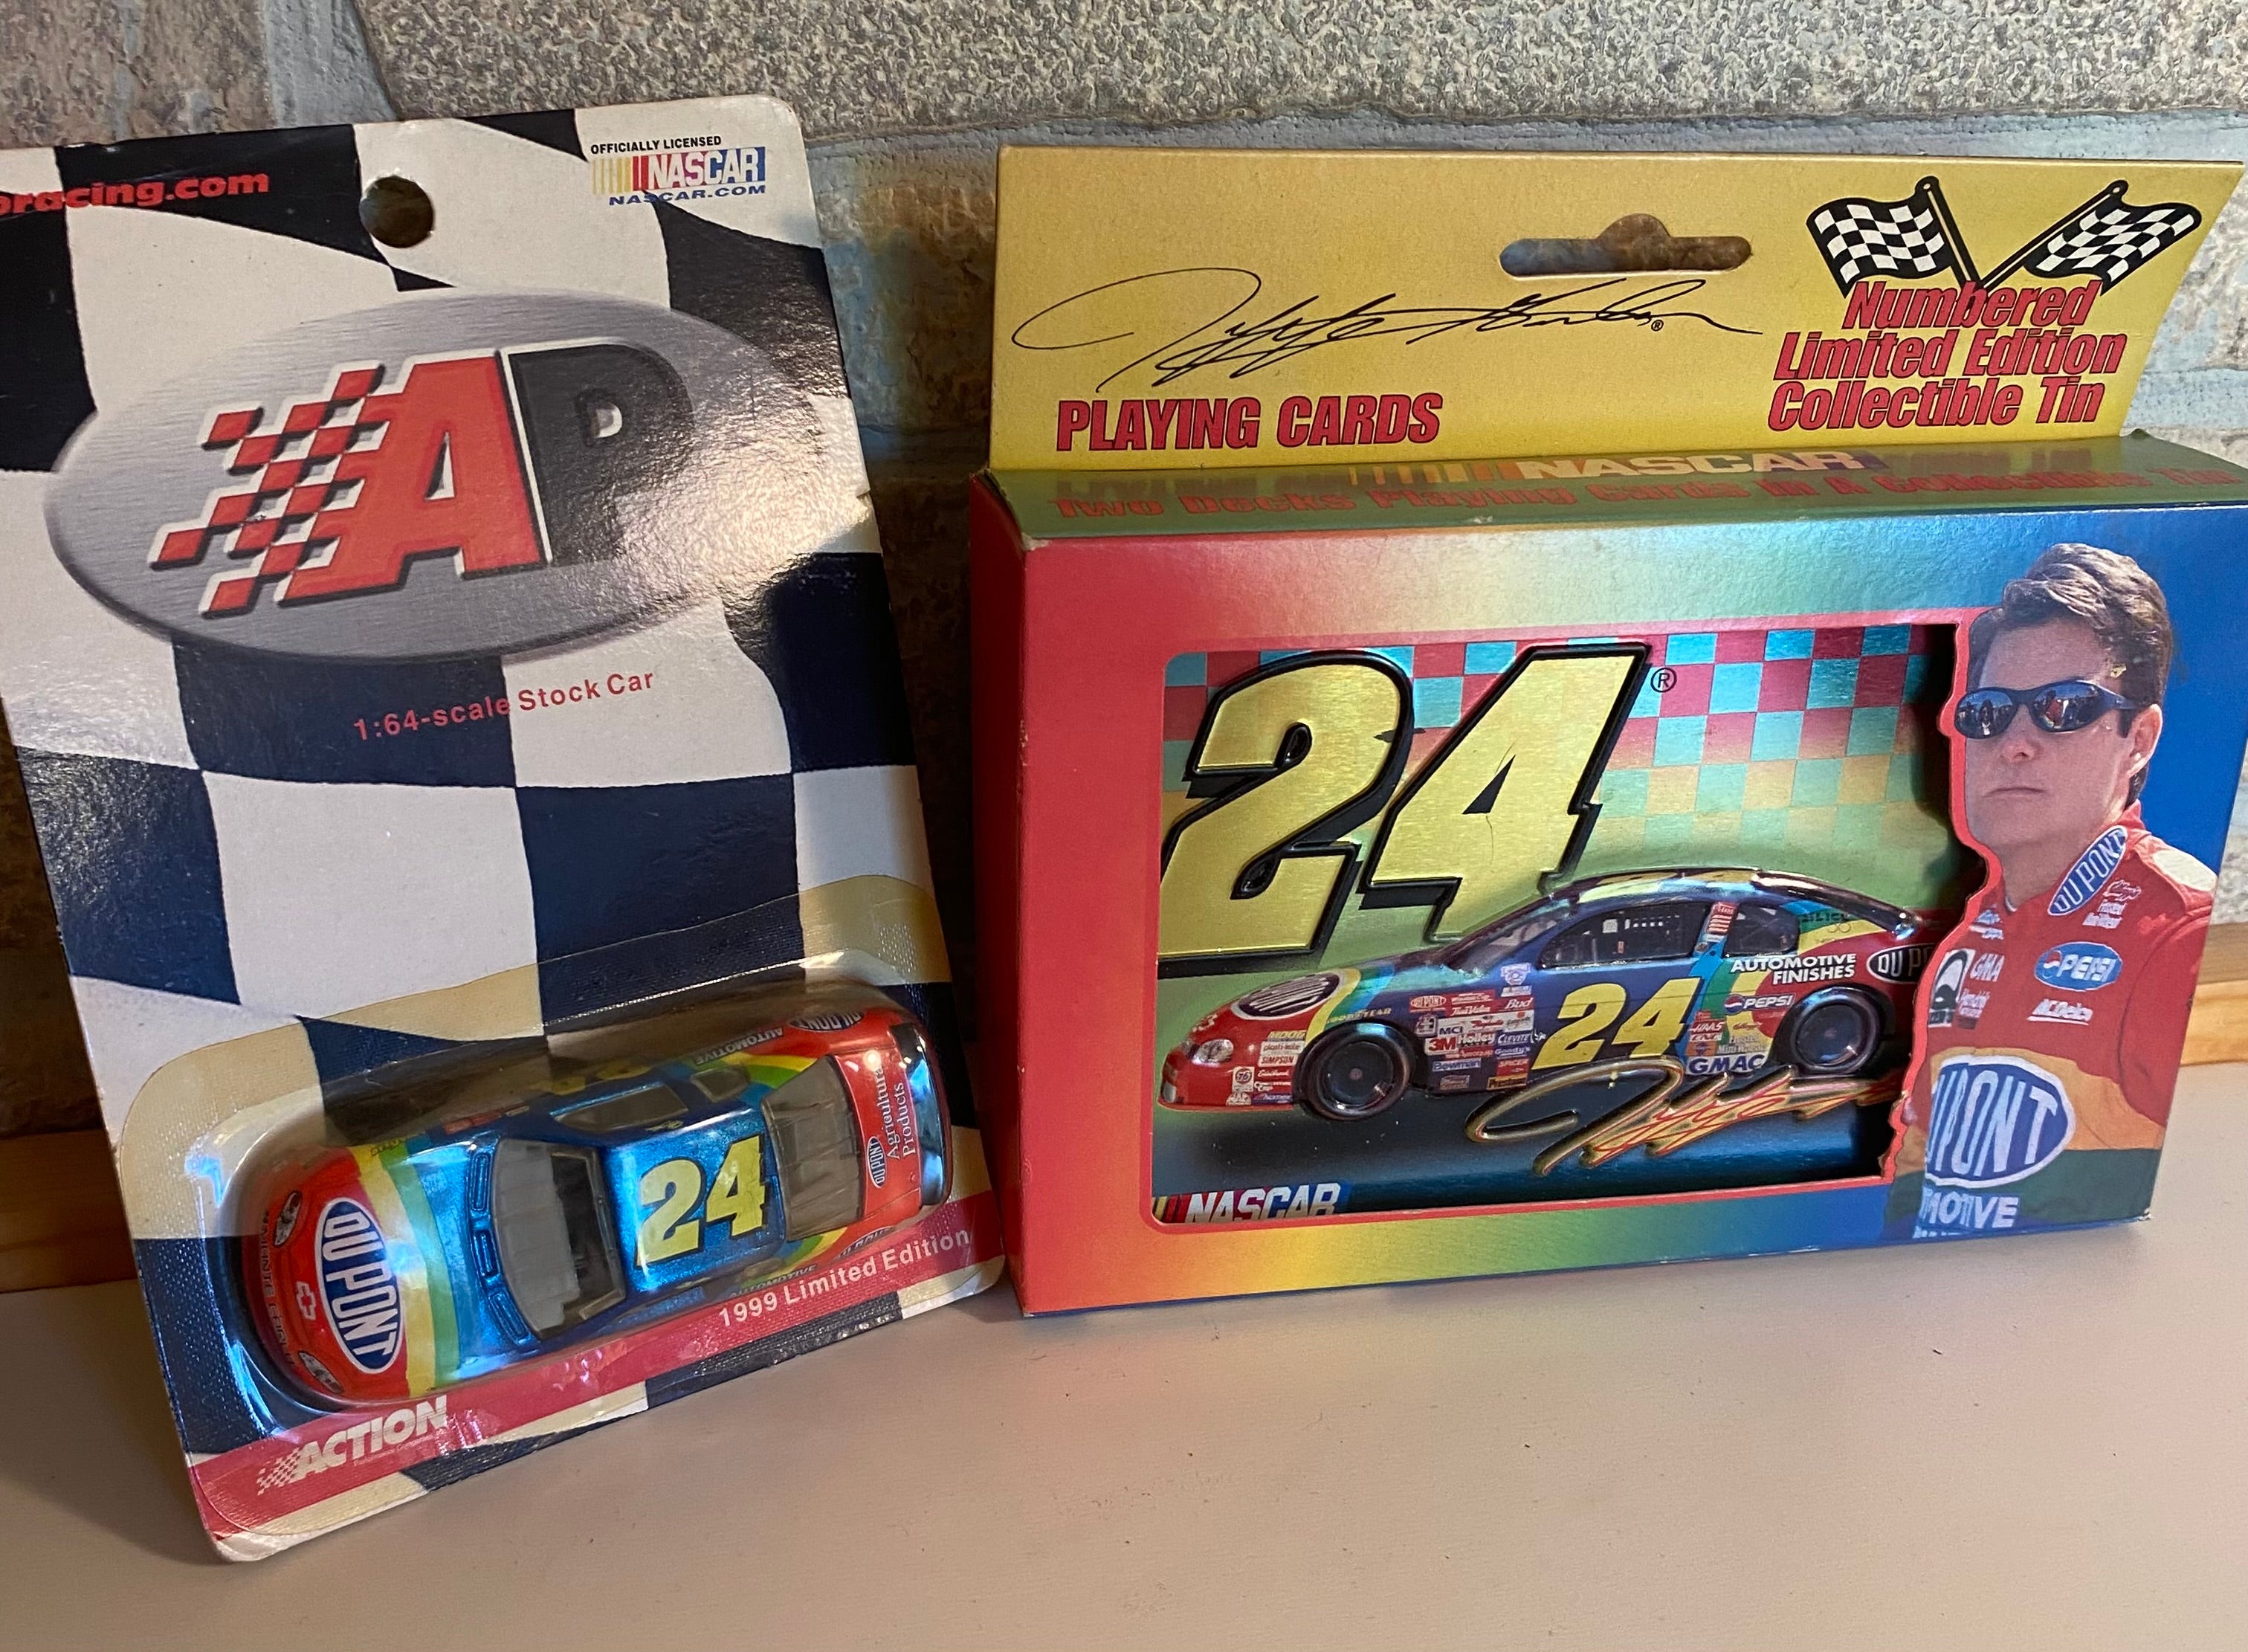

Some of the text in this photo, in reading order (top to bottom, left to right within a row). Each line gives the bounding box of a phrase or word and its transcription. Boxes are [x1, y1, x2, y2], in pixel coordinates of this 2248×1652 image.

[590, 135, 722, 155] OFFICIALLY LICENSED
[647, 147, 759, 190] NASCAR
[608, 185, 766, 206] NASCAR.COM
[1841, 280, 2103, 329] Numbered
[1772, 328, 2128, 381] Limited Edition
[1056, 392, 1444, 452] PLAYING CARDS
[1767, 375, 2105, 431] Collectible Tin
[1515, 451, 1866, 480] NASCAR
[1048, 497, 1165, 518] Two
[1178, 492, 1357, 514] Decks
[1365, 486, 1577, 510] Playing
[1585, 480, 1751, 501] Cards
[1824, 476, 1873, 494] A
[352, 671, 654, 741] 1:64-scale Stock Car
[1157, 639, 1652, 978] 24
[1730, 952, 1857, 973] AUTOMOTIVE
[1772, 964, 1855, 985] FINISHES
[1505, 997, 1534, 1010] Bud
[1742, 994, 1794, 1009] PEPSI
[1428, 1036, 1457, 1051] 3M
[1530, 976, 1702, 1070] 24
[696, 1027, 784, 1066] AUTOMOTIVE
[1261, 1055, 1295, 1064] SIMPSON
[1687, 1054, 1766, 1074] GMAC
[874, 1063, 901, 1161] Agricultura
[894, 1081, 917, 1158] Products
[635, 1134, 769, 1268] 24
[1184, 1182, 1342, 1224] NASCAR
[718, 1291, 778, 1328] 1999
[783, 1258, 877, 1306] Limited
[881, 1228, 971, 1271] Edition
[286, 1394, 448, 1484] ACTION
